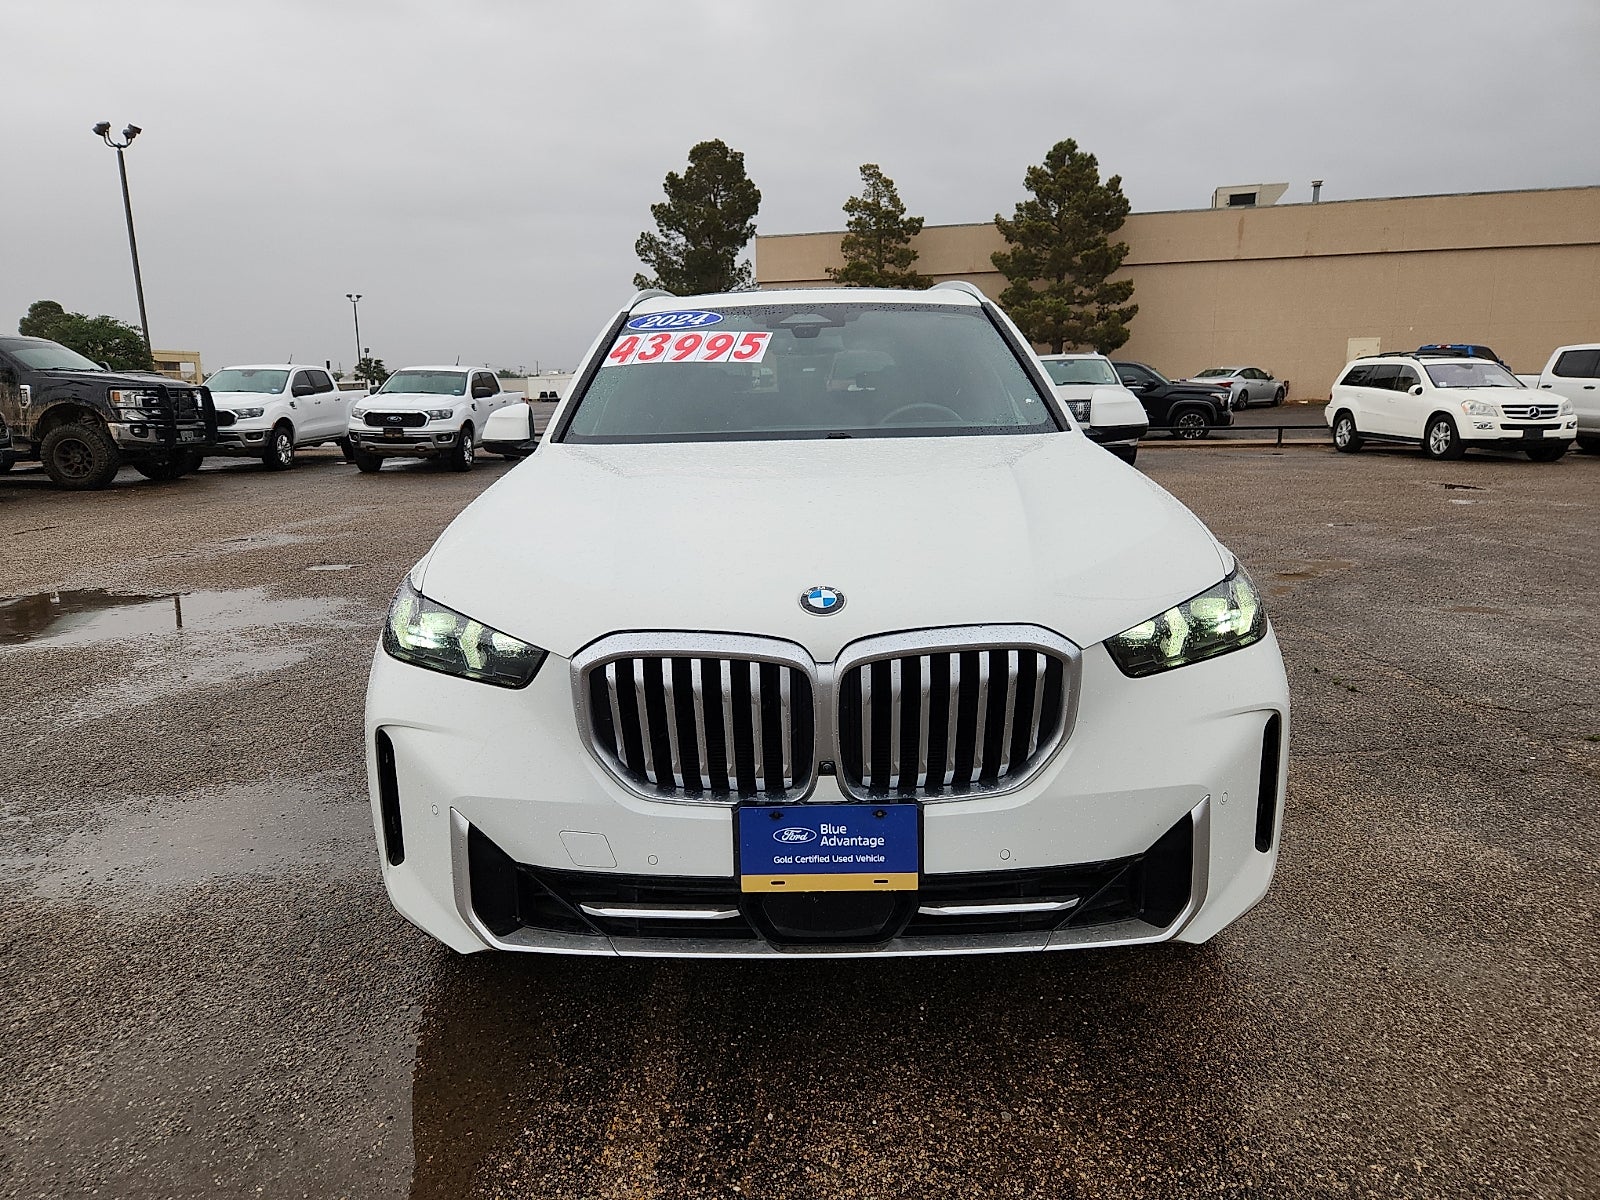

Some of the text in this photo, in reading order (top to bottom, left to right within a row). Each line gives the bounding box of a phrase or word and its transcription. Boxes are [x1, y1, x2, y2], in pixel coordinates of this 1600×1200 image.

[640, 312, 707, 329] 2024
[609, 333, 768, 363] 43995
[781, 829, 808, 841] Ford
[820, 824, 847, 834] Blue
[820, 835, 885, 848] Advantage
[773, 854, 885, 864] Gold Certified Used Vehicle
